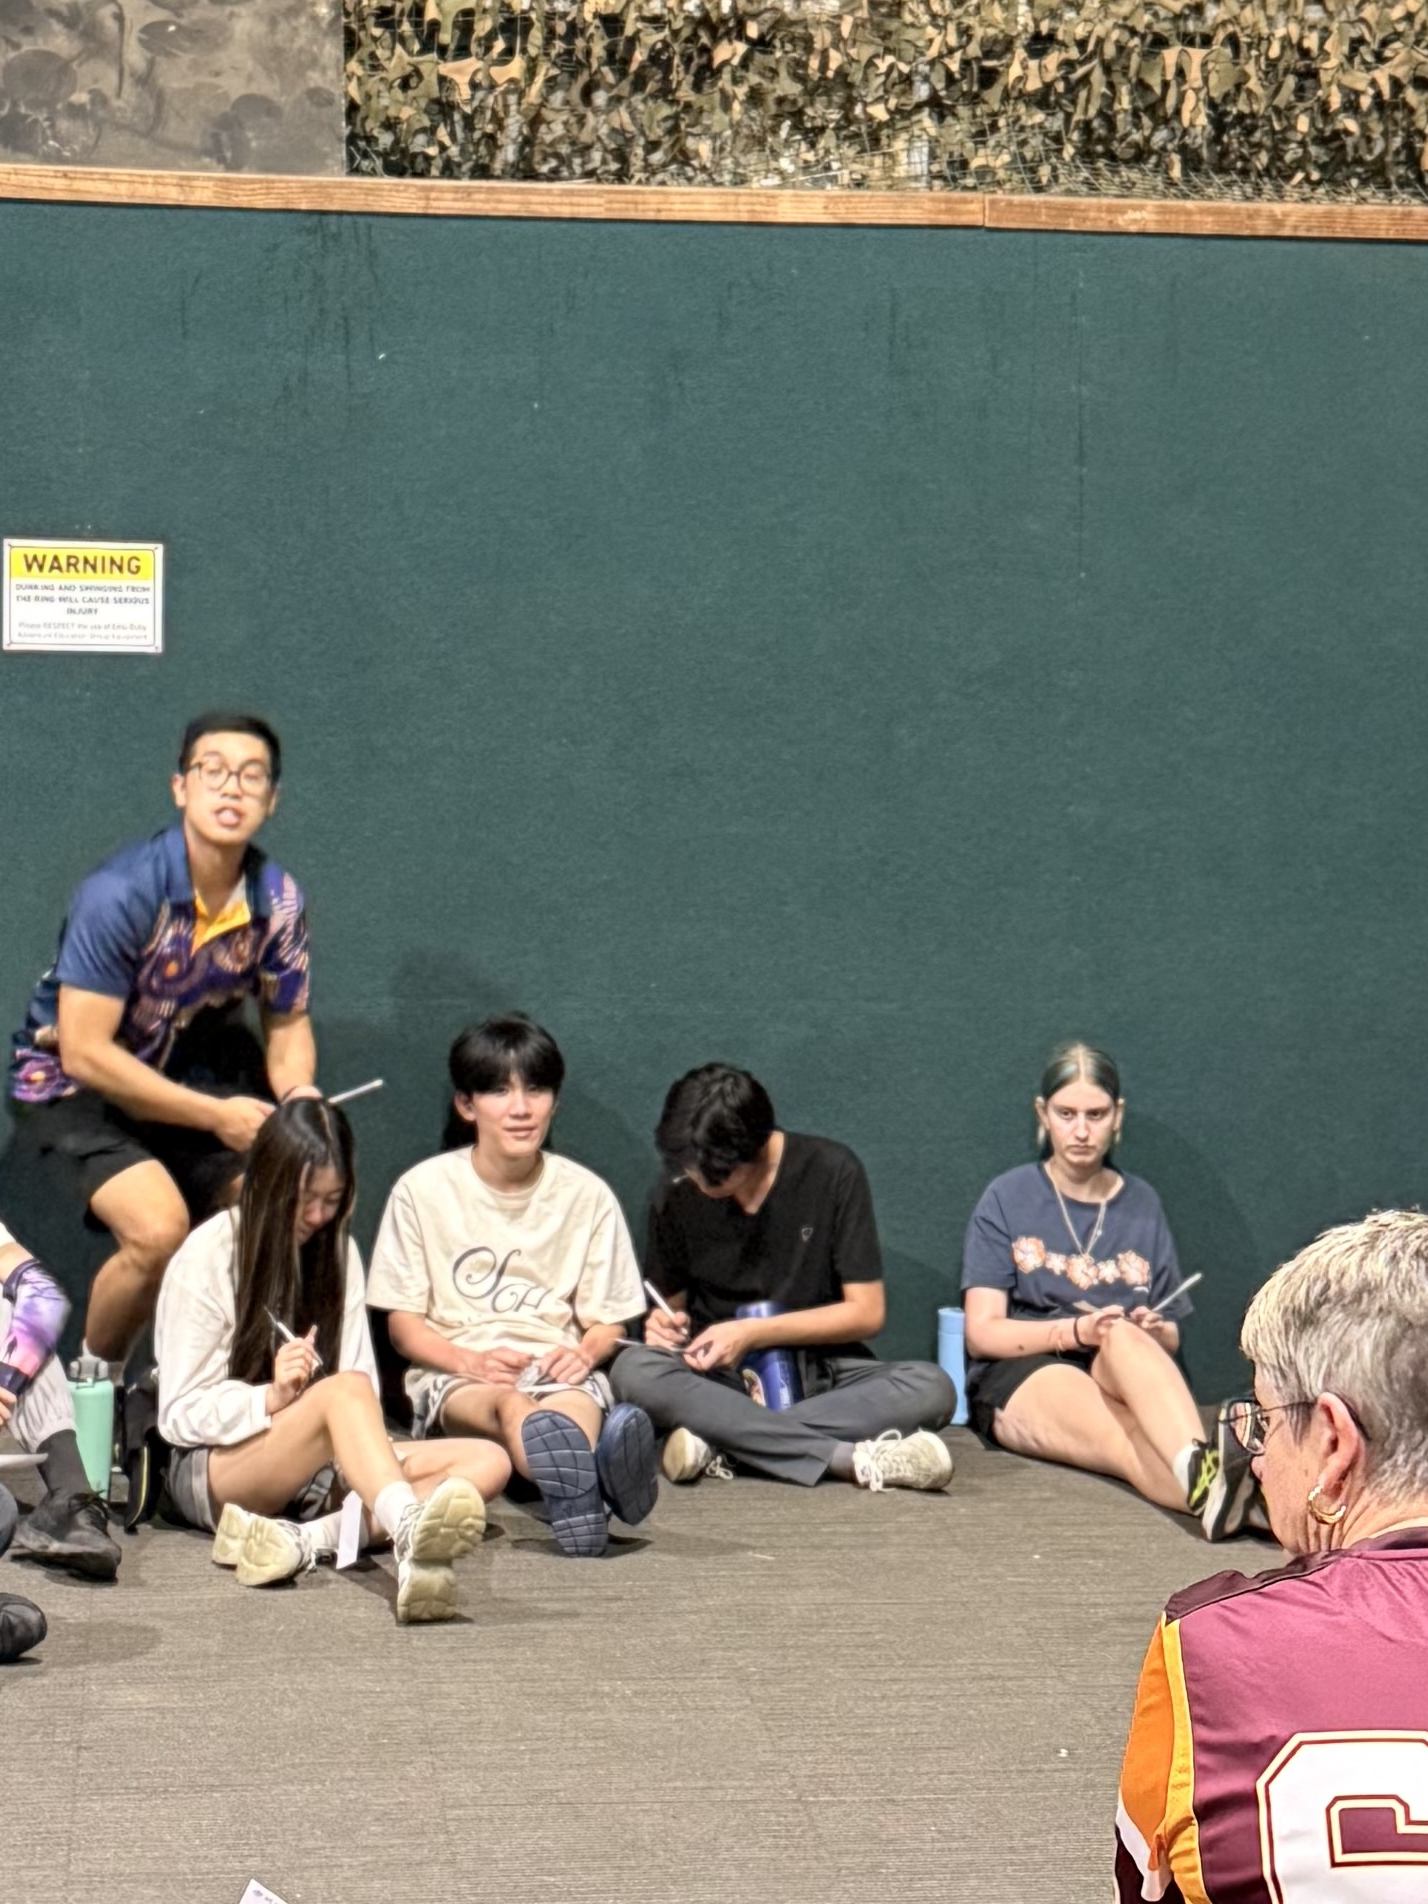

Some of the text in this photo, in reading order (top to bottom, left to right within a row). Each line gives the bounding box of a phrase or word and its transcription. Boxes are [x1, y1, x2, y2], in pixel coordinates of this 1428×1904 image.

[23, 553, 141, 575] WARNING
[58, 584, 77, 592] AND
[79, 585, 123, 593] SWINGING
[126, 585, 150, 593] FROM
[58, 596, 79, 604] WILL
[82, 596, 110, 604] CAUSE
[113, 596, 150, 605] SERIOUS
[66, 607, 98, 615] INJURY
